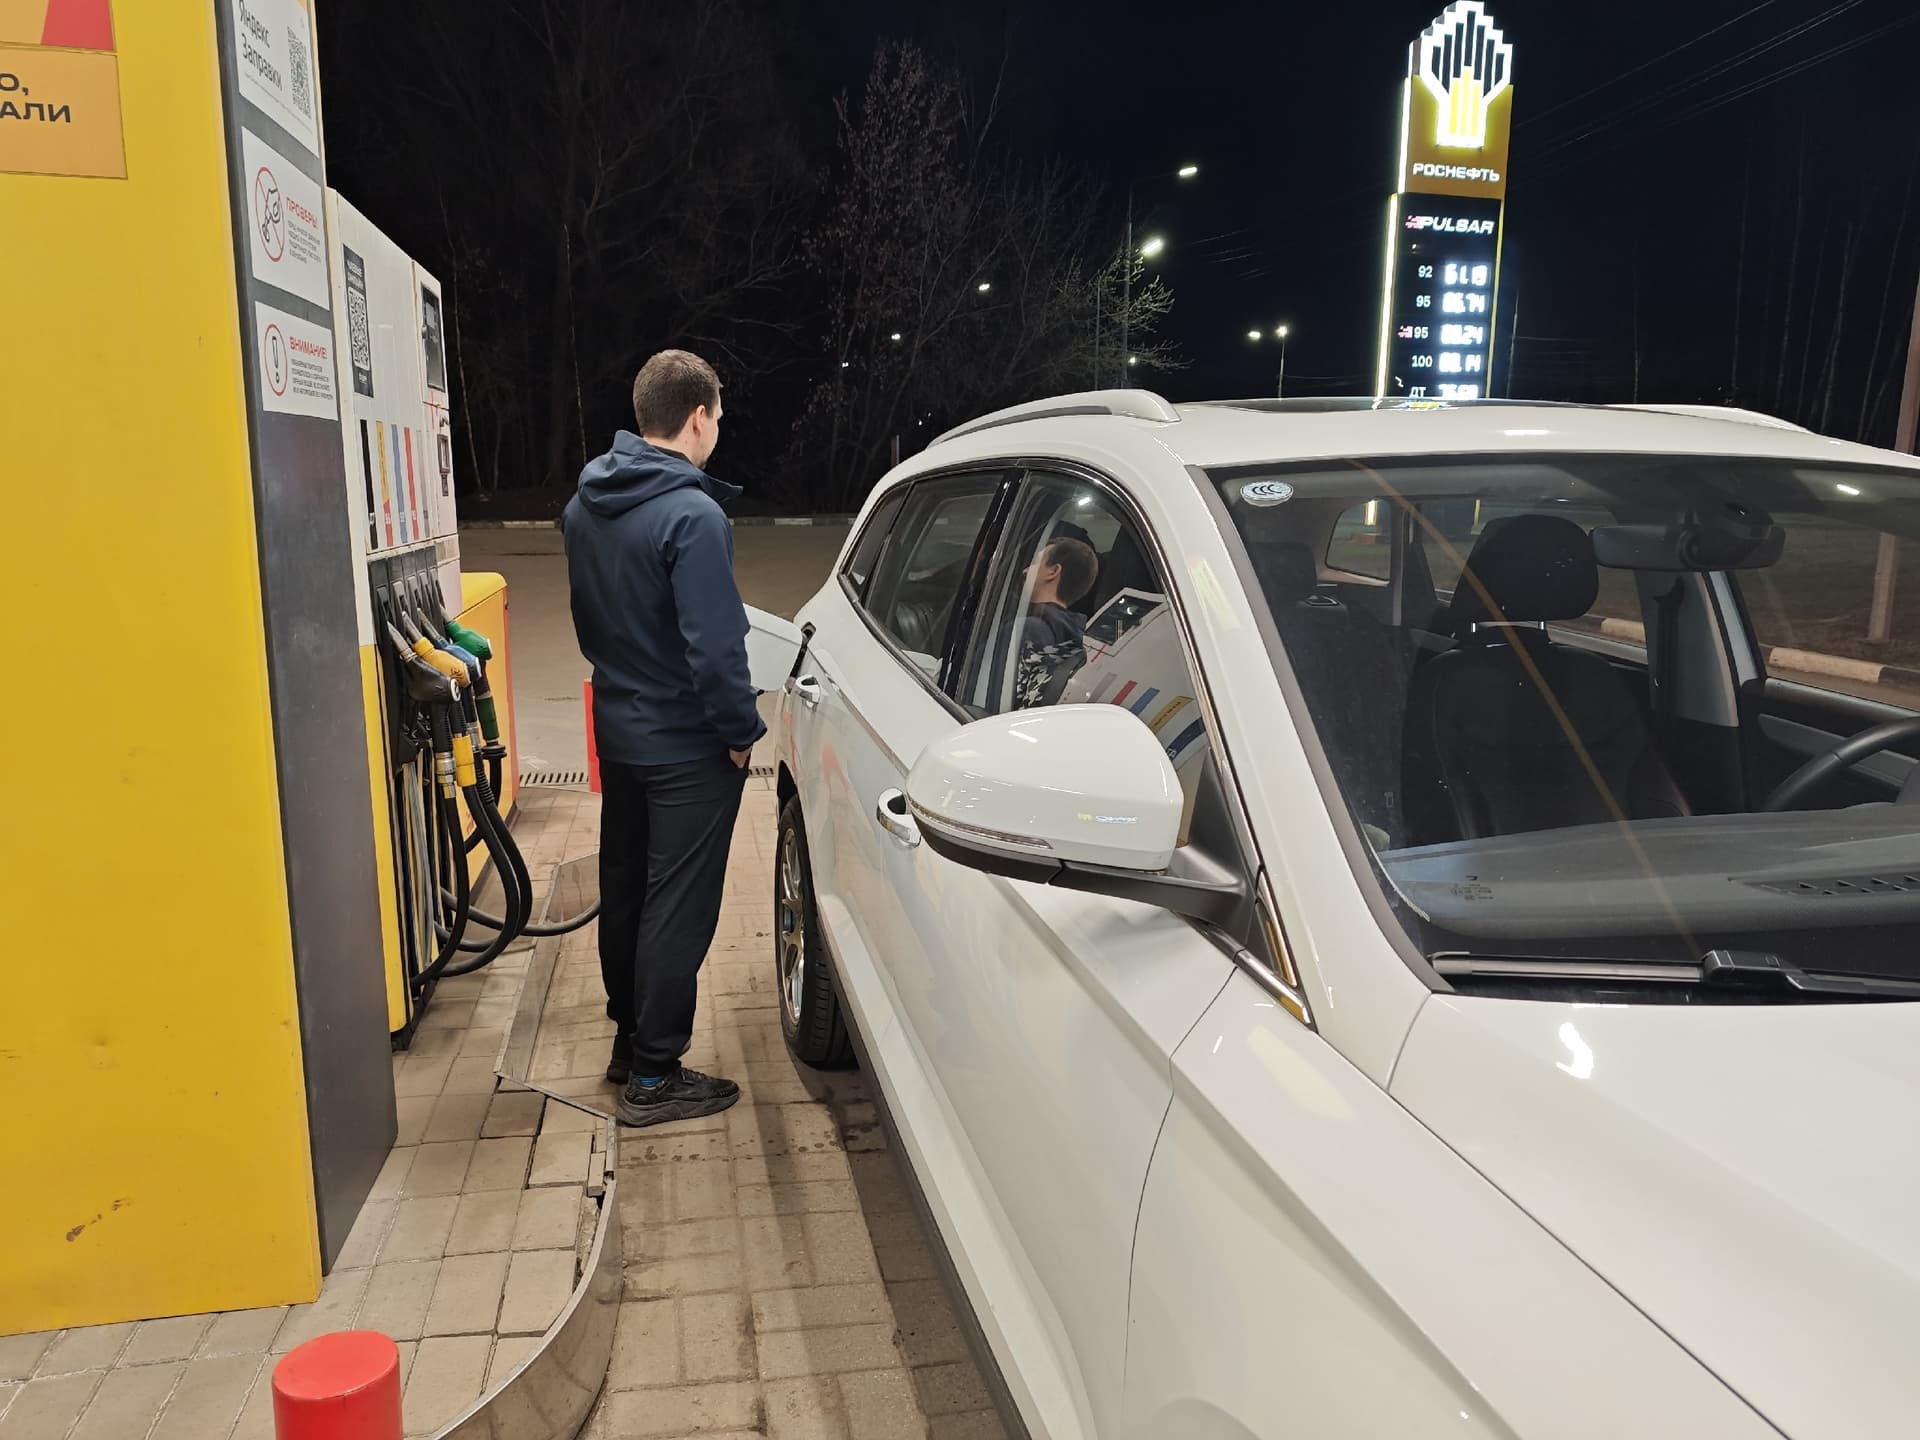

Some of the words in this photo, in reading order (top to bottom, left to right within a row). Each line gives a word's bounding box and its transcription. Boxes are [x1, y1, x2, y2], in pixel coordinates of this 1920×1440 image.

[239, 0, 270, 49] Яндекс
[242, 32, 283, 92] Заправки
[1412, 162, 1500, 182] РОСНЕФТЬ
[1421, 216, 1495, 234] PULSAR
[1418, 265, 1433, 278] 92
[1416, 295, 1431, 308] 95
[1414, 326, 1429, 339] 95
[1411, 355, 1433, 368] 100
[1408, 386, 1427, 399] ДТ
